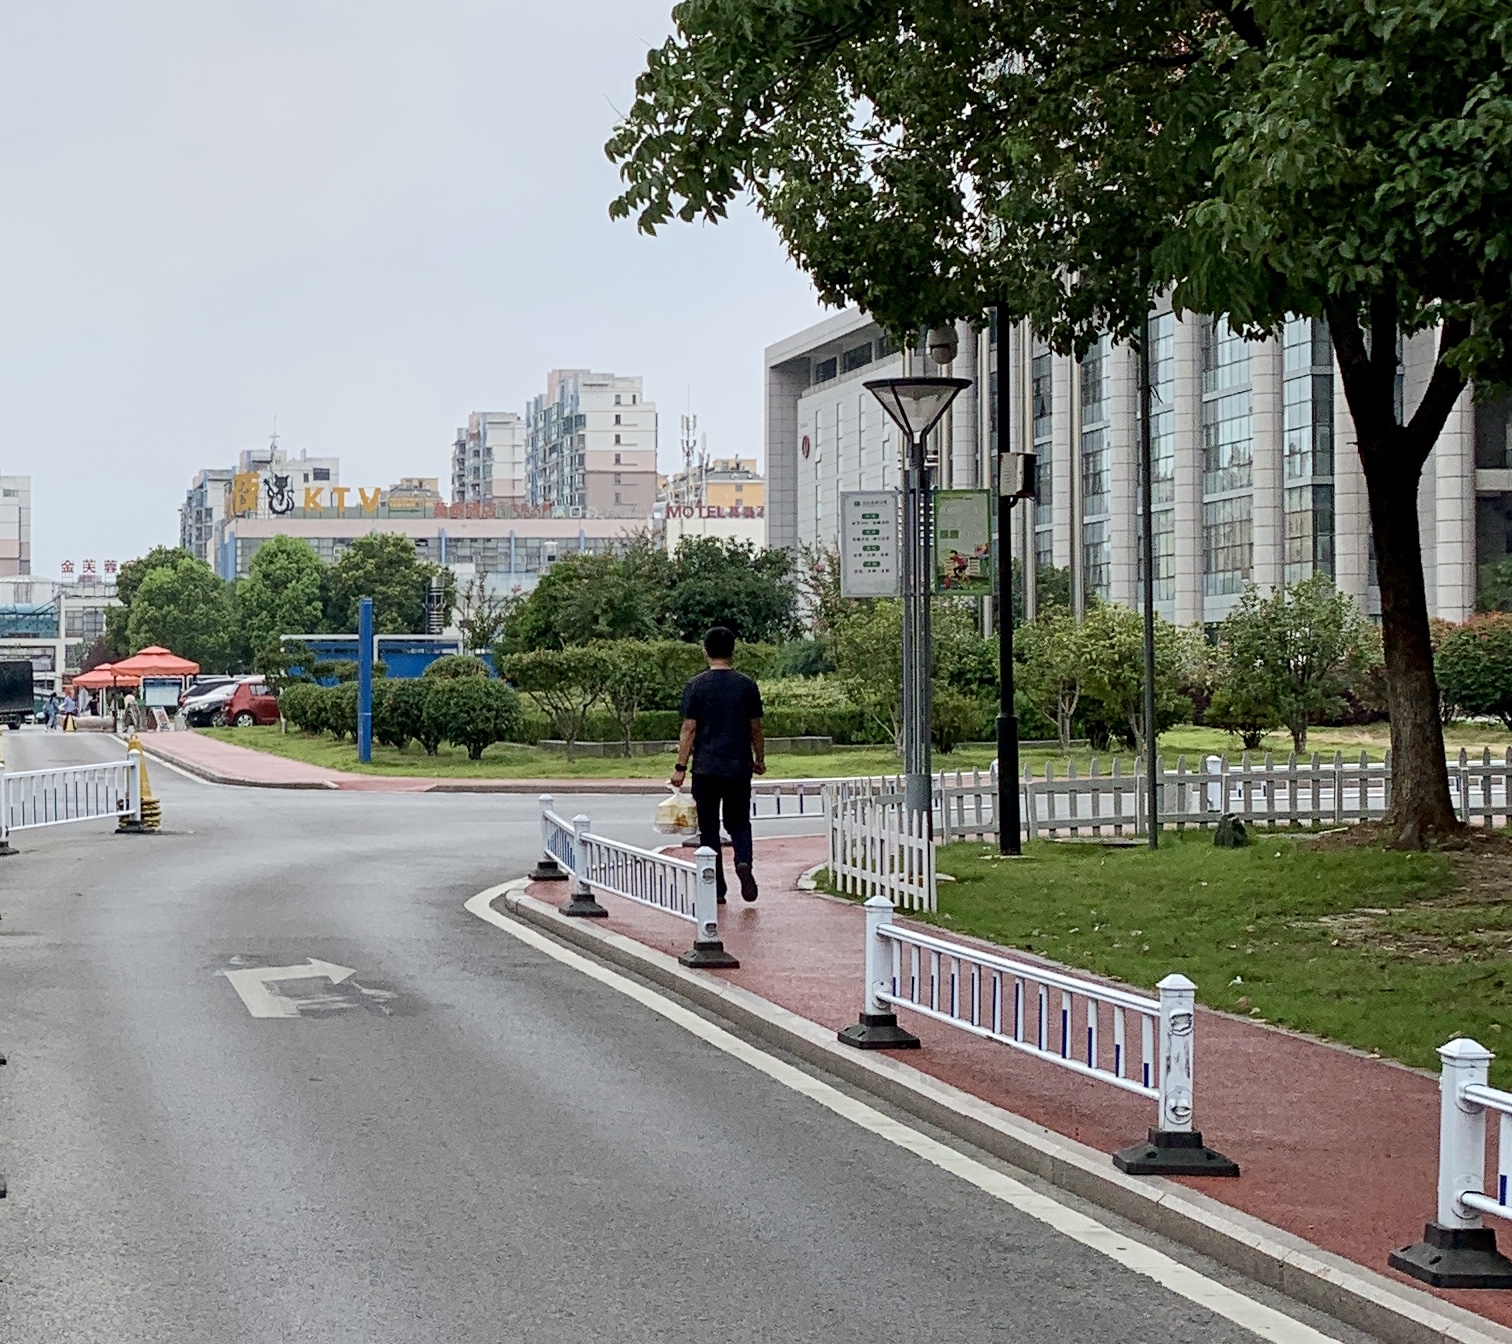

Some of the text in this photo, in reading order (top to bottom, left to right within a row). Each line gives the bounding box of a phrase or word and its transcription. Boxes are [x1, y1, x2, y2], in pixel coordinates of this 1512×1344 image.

[303, 487, 382, 513] KTV
[666, 504, 726, 520] MOTEL
[61, 558, 136, 573] 金芙蓉
